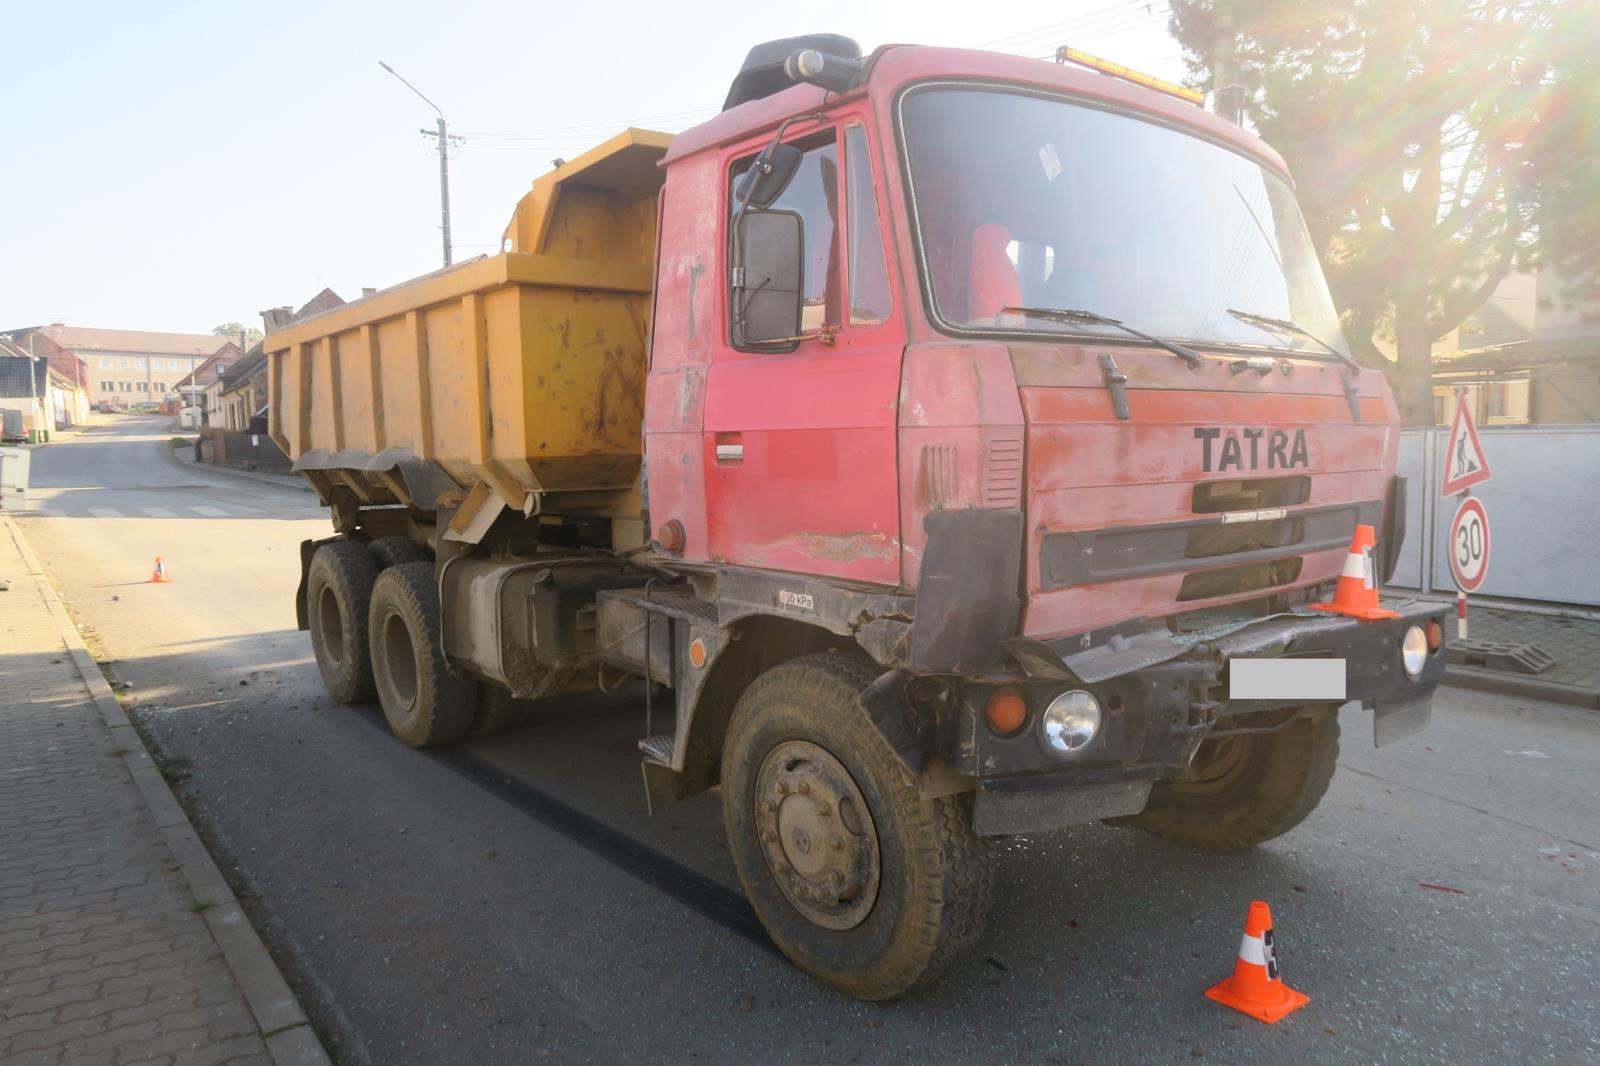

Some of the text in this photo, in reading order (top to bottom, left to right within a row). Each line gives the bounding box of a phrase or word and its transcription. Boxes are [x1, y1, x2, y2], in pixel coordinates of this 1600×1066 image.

[1194, 427, 1309, 472] TATRA
[1457, 518, 1481, 568] 30
[796, 595, 812, 607] kPa
